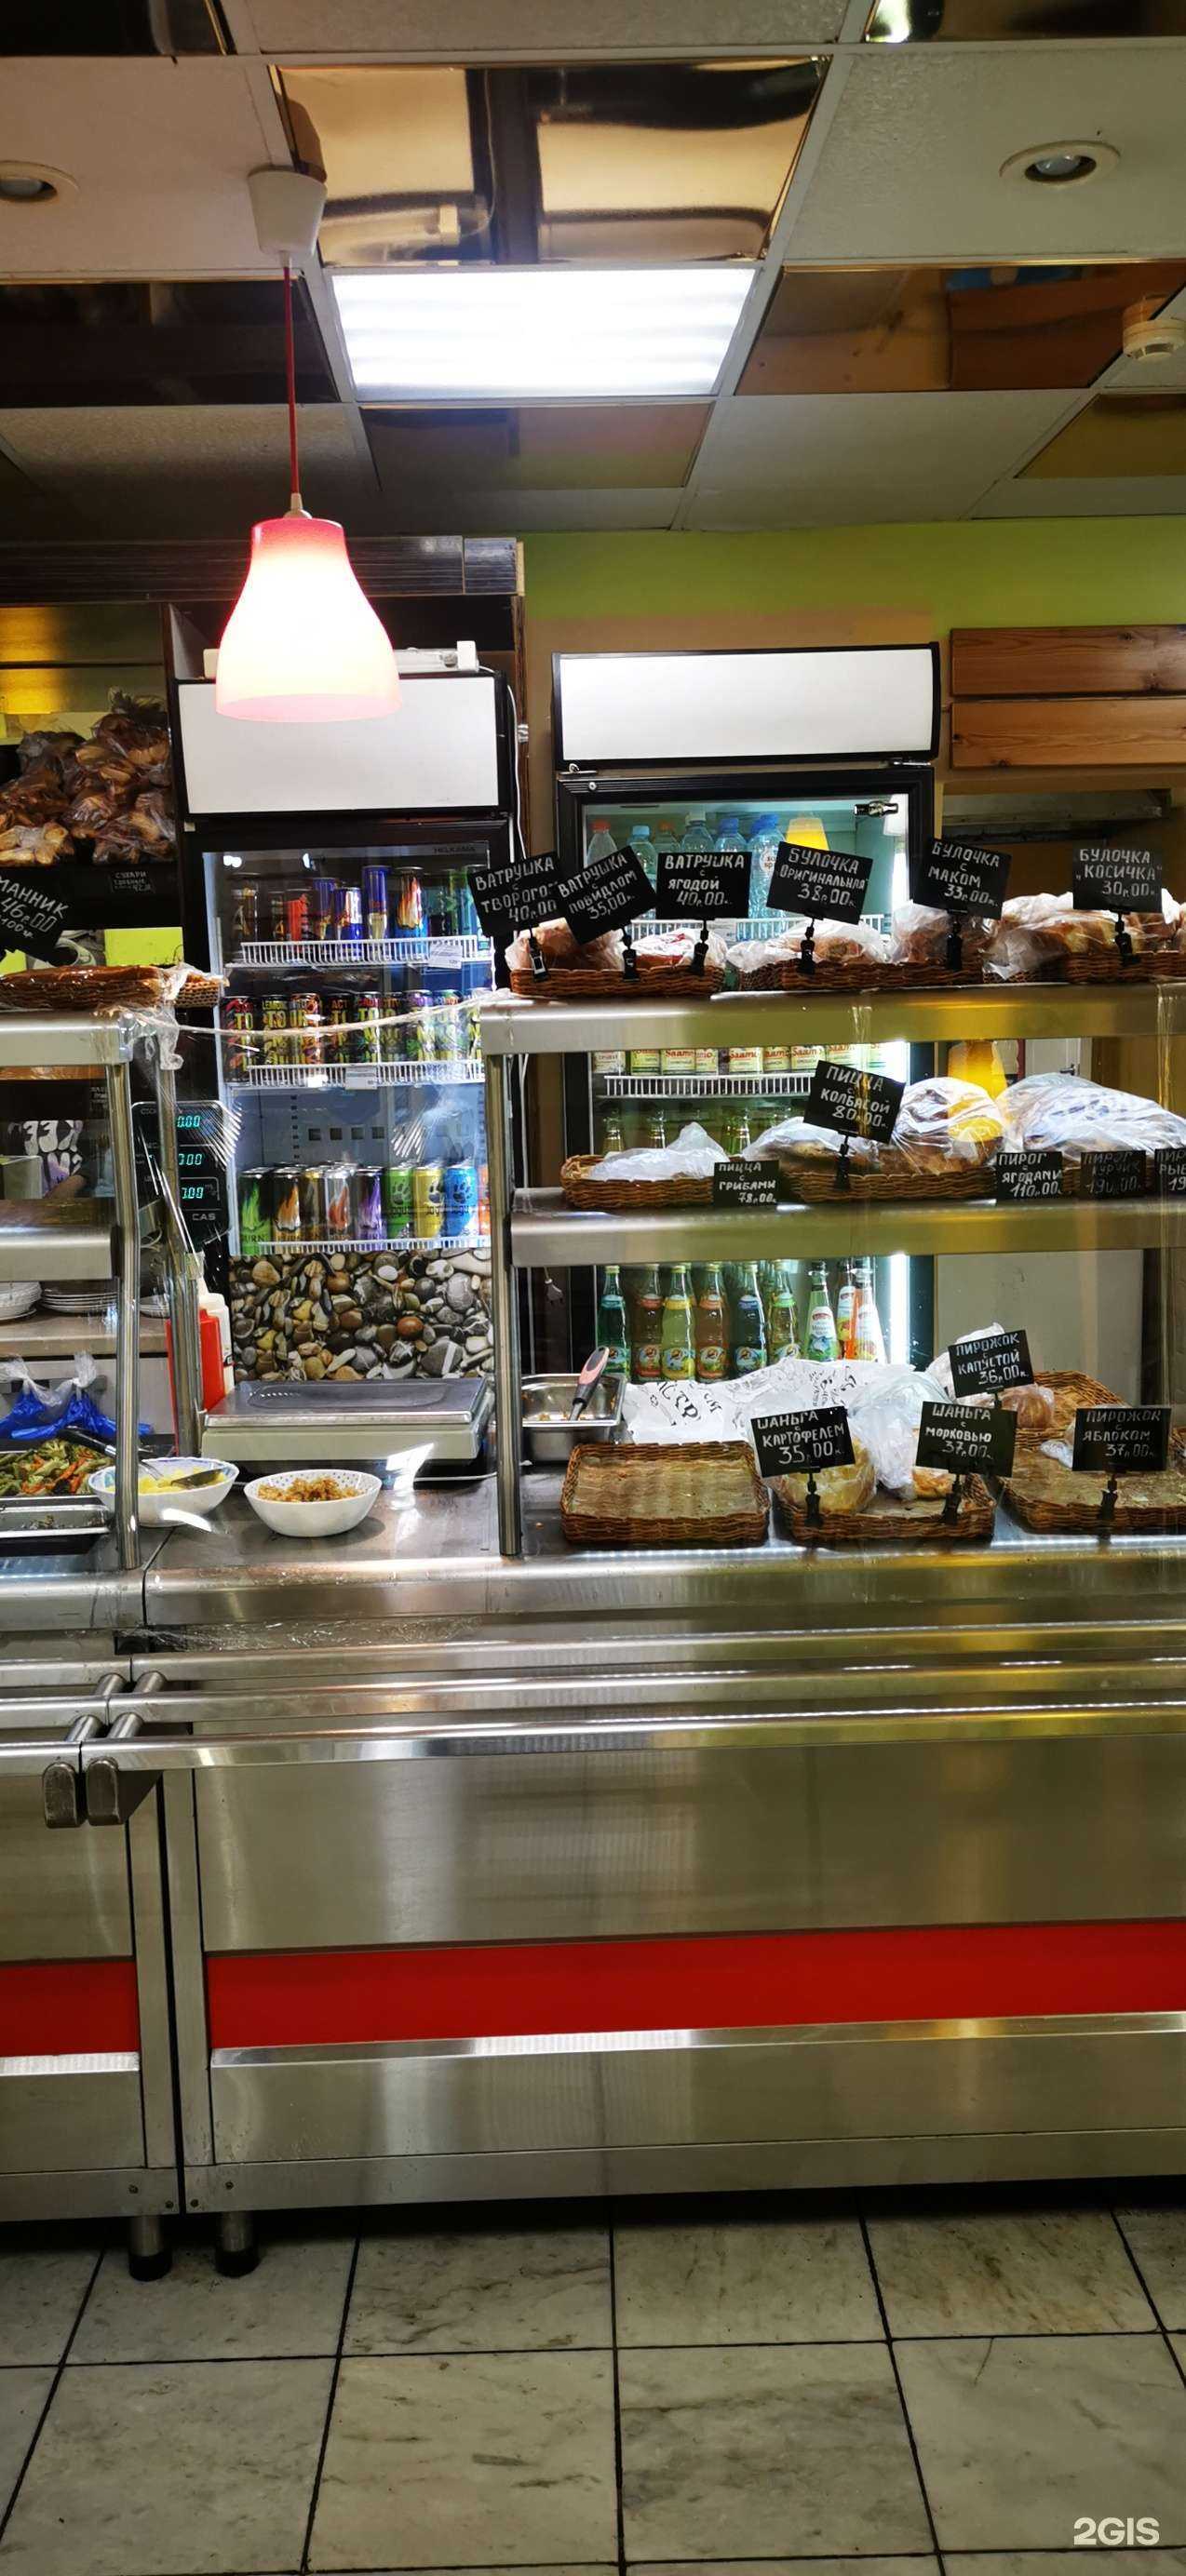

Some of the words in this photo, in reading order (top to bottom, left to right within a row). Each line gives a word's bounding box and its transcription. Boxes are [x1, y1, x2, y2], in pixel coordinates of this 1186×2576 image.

[665, 854, 745, 869] ВАТРУШКА
[788, 848, 859, 874] БУЛОЧКА
[932, 842, 999, 866] БУЛОЧКА
[1080, 849, 1151, 864] БУЛОЧКА
[476, 856, 555, 891] ВАТРУШКА
[558, 853, 627, 898] ВАТРУШКА
[928, 866, 981, 888] МАКОМ
[668, 876, 720, 892] ЯГОДОЙ
[0, 876, 69, 919] МАННИК
[480, 880, 559, 913] ТВОРОГО
[820, 1088, 891, 1114] КОЛБАСОЙ
[719, 1161, 761, 1174] ПИЦЦА
[999, 1153, 1047, 1166] ПИРОГ
[719, 1179, 776, 1191] ГРИБАМИ
[192, 1213, 216, 1221] CAS
[956, 1333, 1019, 1356] ПИРОЖОК
[958, 1348, 1020, 1375] КАПУСТОЙ
[757, 1410, 818, 1429] ШАНЬГА
[932, 1403, 991, 1421] ШАНЬГА
[1086, 1410, 1161, 1423] ПИРОЖОК
[762, 1423, 844, 1448] КАРТОФЕЛЕМ
[1083, 1430, 1151, 1442] ЯБЛОКОМ
